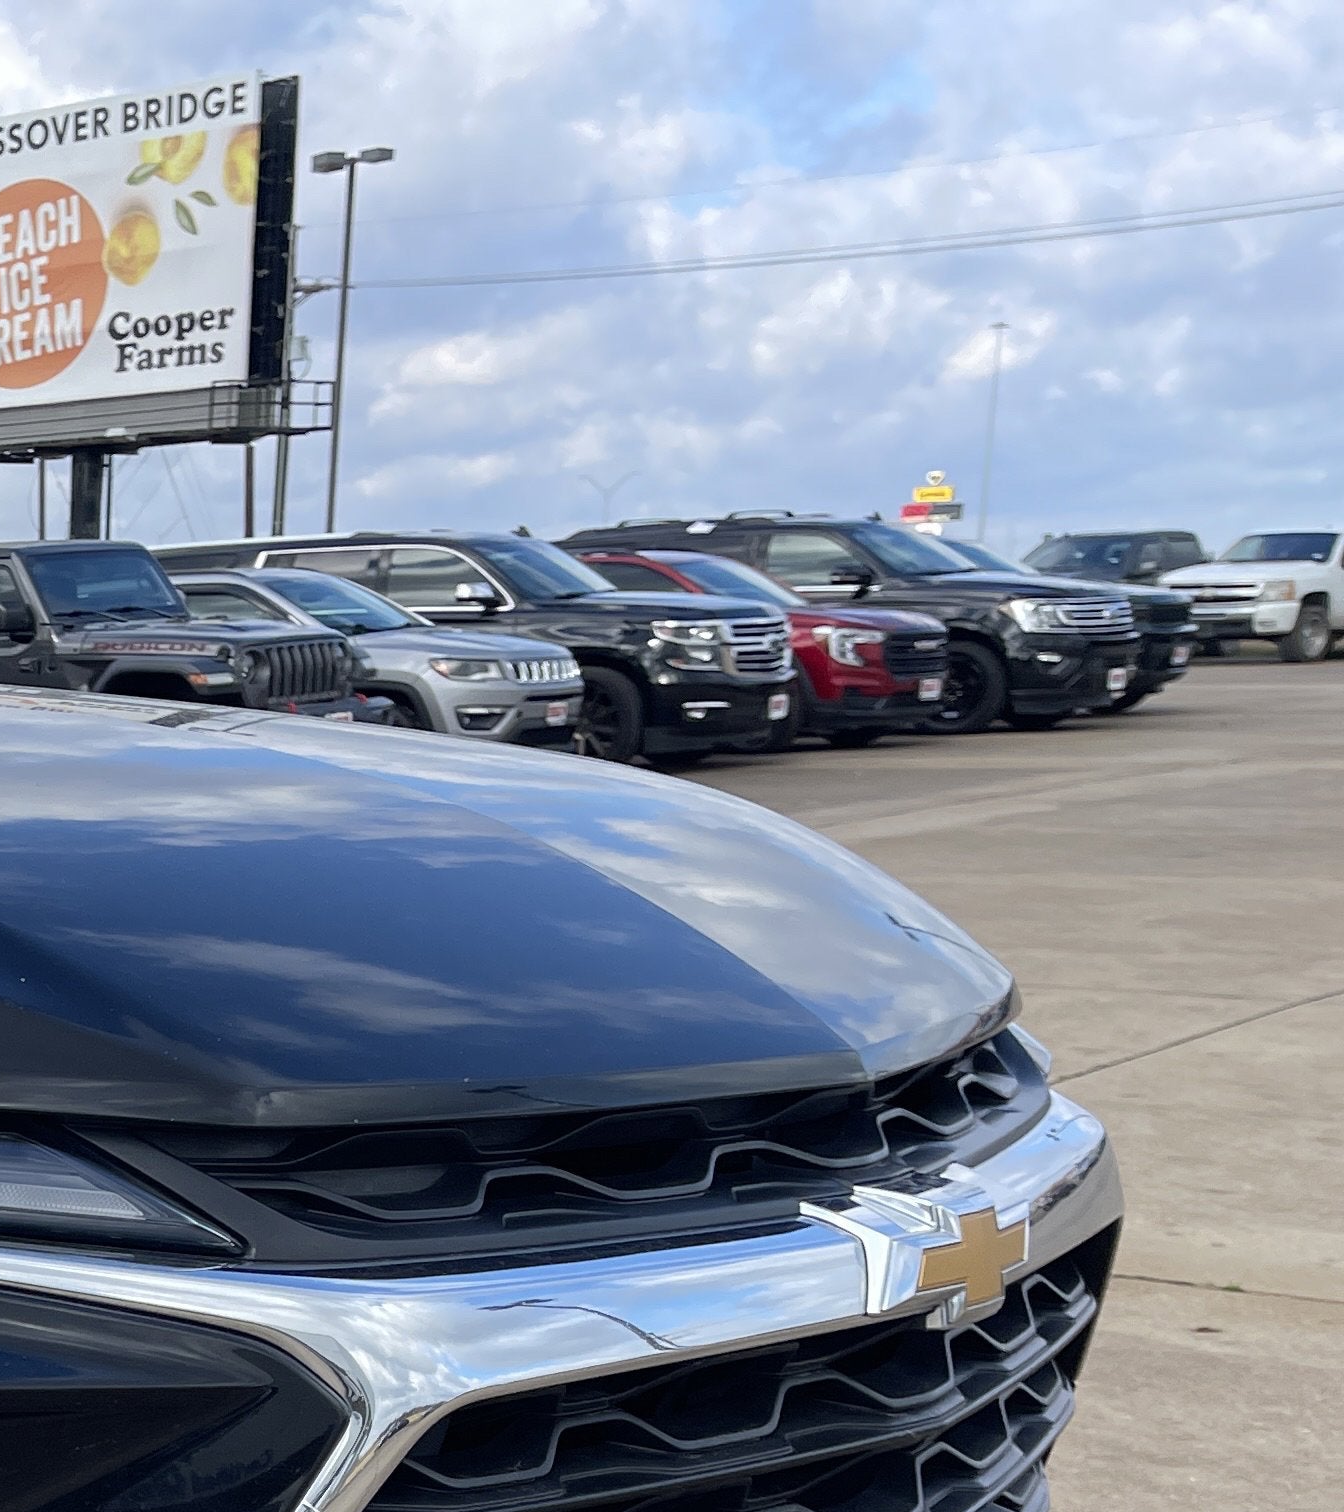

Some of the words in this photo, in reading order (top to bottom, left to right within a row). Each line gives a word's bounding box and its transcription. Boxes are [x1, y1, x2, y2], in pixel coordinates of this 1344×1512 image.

[122, 81, 248, 134] BRIDGE
[108, 305, 235, 343] Cooper
[114, 340, 225, 374] Farms
